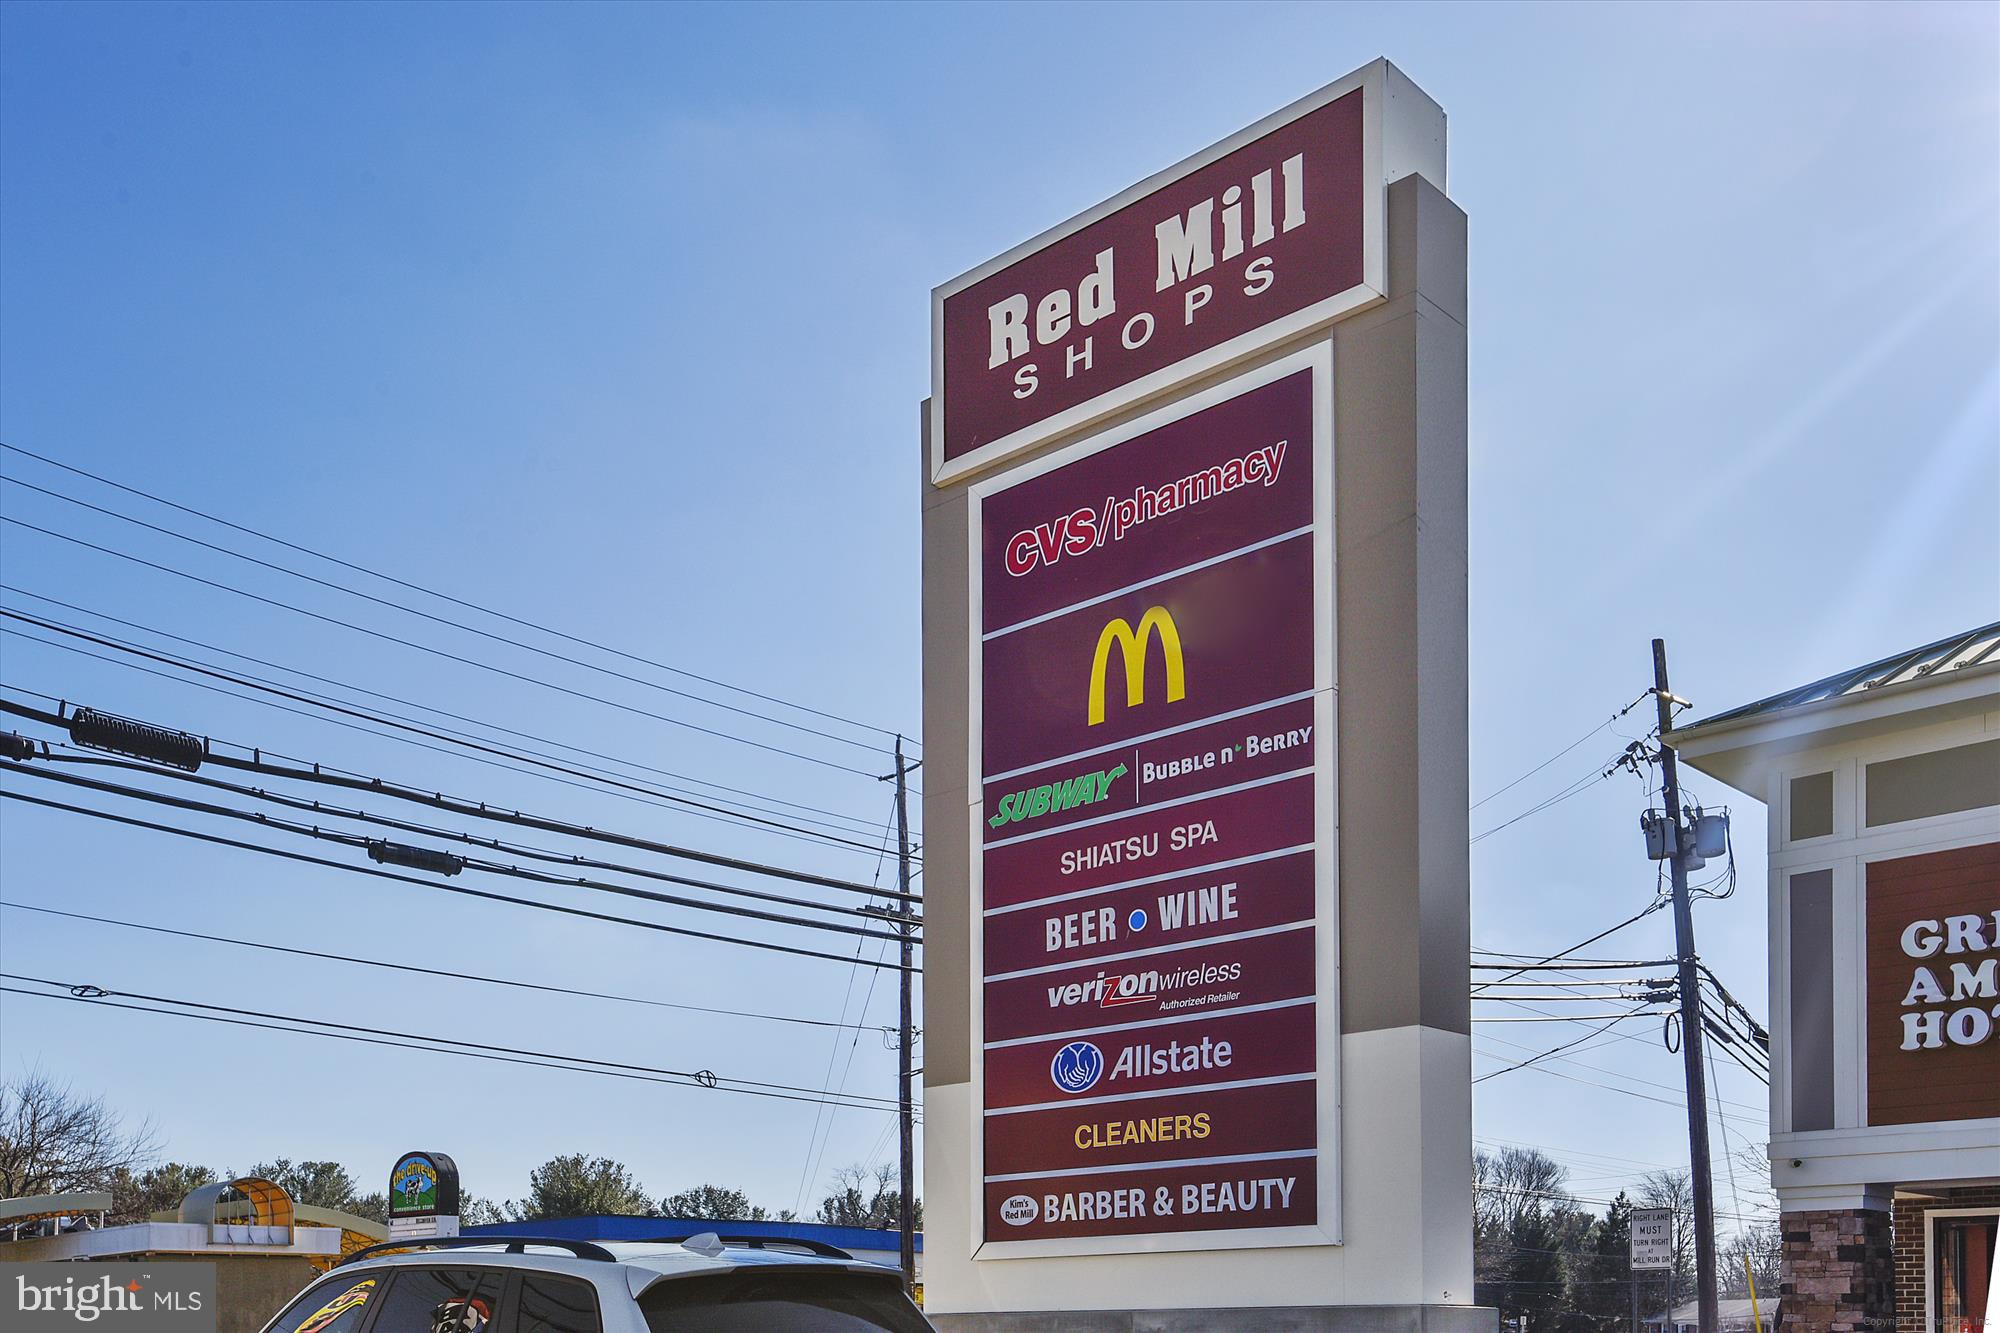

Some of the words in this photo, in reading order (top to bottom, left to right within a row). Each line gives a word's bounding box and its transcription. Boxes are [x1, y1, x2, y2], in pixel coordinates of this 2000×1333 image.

[988, 246, 1116, 371] Red
[1155, 152, 1306, 293] Mill
[1013, 256, 1276, 400] SHOPS
[1004, 440, 1288, 577] CVS/pharmacy
[987, 763, 1129, 829] SUBWAY
[1060, 832, 1159, 876] SHIATSU
[1170, 820, 1219, 853] SPA
[1045, 907, 1116, 953] BEER
[1158, 882, 1239, 931] WINE
[1900, 910, 2000, 958] GR
[1159, 996, 1207, 1011] Authorized
[1207, 991, 1241, 1005] Retailer
[1900, 1003, 2000, 1051] HO
[1109, 1035, 1233, 1082] Allstate
[1074, 1112, 1212, 1150] CLEANERS
[393, 1168, 405, 1187] the
[406, 1162, 437, 1186] drive-up
[1005, 1211, 1019, 1220] Red
[1020, 1209, 1034, 1218] Mill
[1009, 1199, 1029, 1209] Kim's
[1044, 1188, 1146, 1223] BARBER
[1152, 1187, 1175, 1216] &
[1181, 1176, 1297, 1214] BEAUTY
[1640, 1226, 1661, 1234] MUST
[1651, 1238, 1669, 1246] RIGHT
[1662, 1255, 1671, 1263] DR
